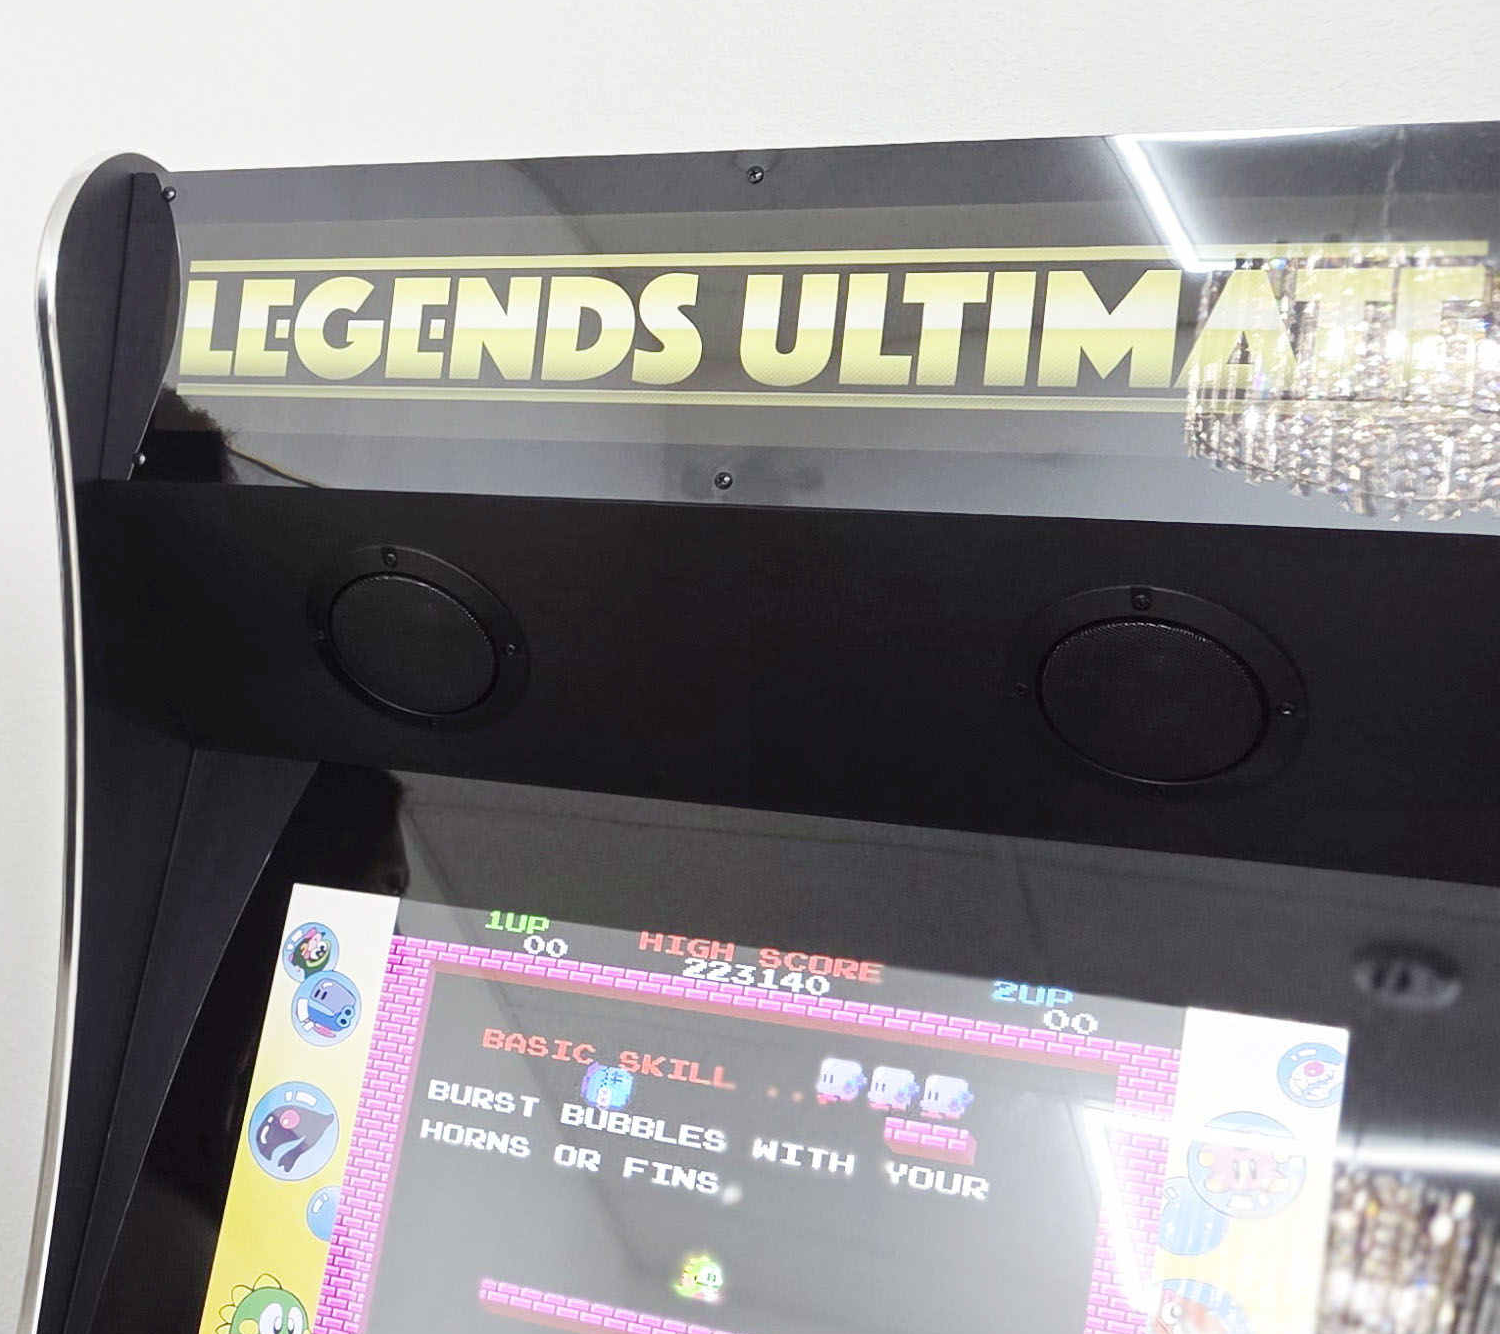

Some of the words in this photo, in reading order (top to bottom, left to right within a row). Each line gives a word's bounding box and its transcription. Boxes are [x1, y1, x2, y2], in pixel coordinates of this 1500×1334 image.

[179, 273, 704, 385] LEGENDS
[737, 267, 1486, 390] ULTIMATE
[485, 910, 551, 935] 1UP
[522, 934, 568, 958] 00
[638, 931, 735, 962] HIGH
[758, 947, 885, 984] SCORE
[681, 957, 831, 997] 223140
[991, 980, 1076, 1009] 2UP
[1042, 1010, 1099, 1036] 00
[482, 1027, 596, 1065] BASIC
[618, 1050, 737, 1091] SKILL
[419, 1118, 532, 1159] HORNS
[553, 1143, 602, 1173] OR
[427, 1078, 540, 1118] BURST
[559, 1103, 727, 1153] BUBBLES
[752, 1137, 856, 1175] WITH
[886, 1160, 990, 1202] YOUR
